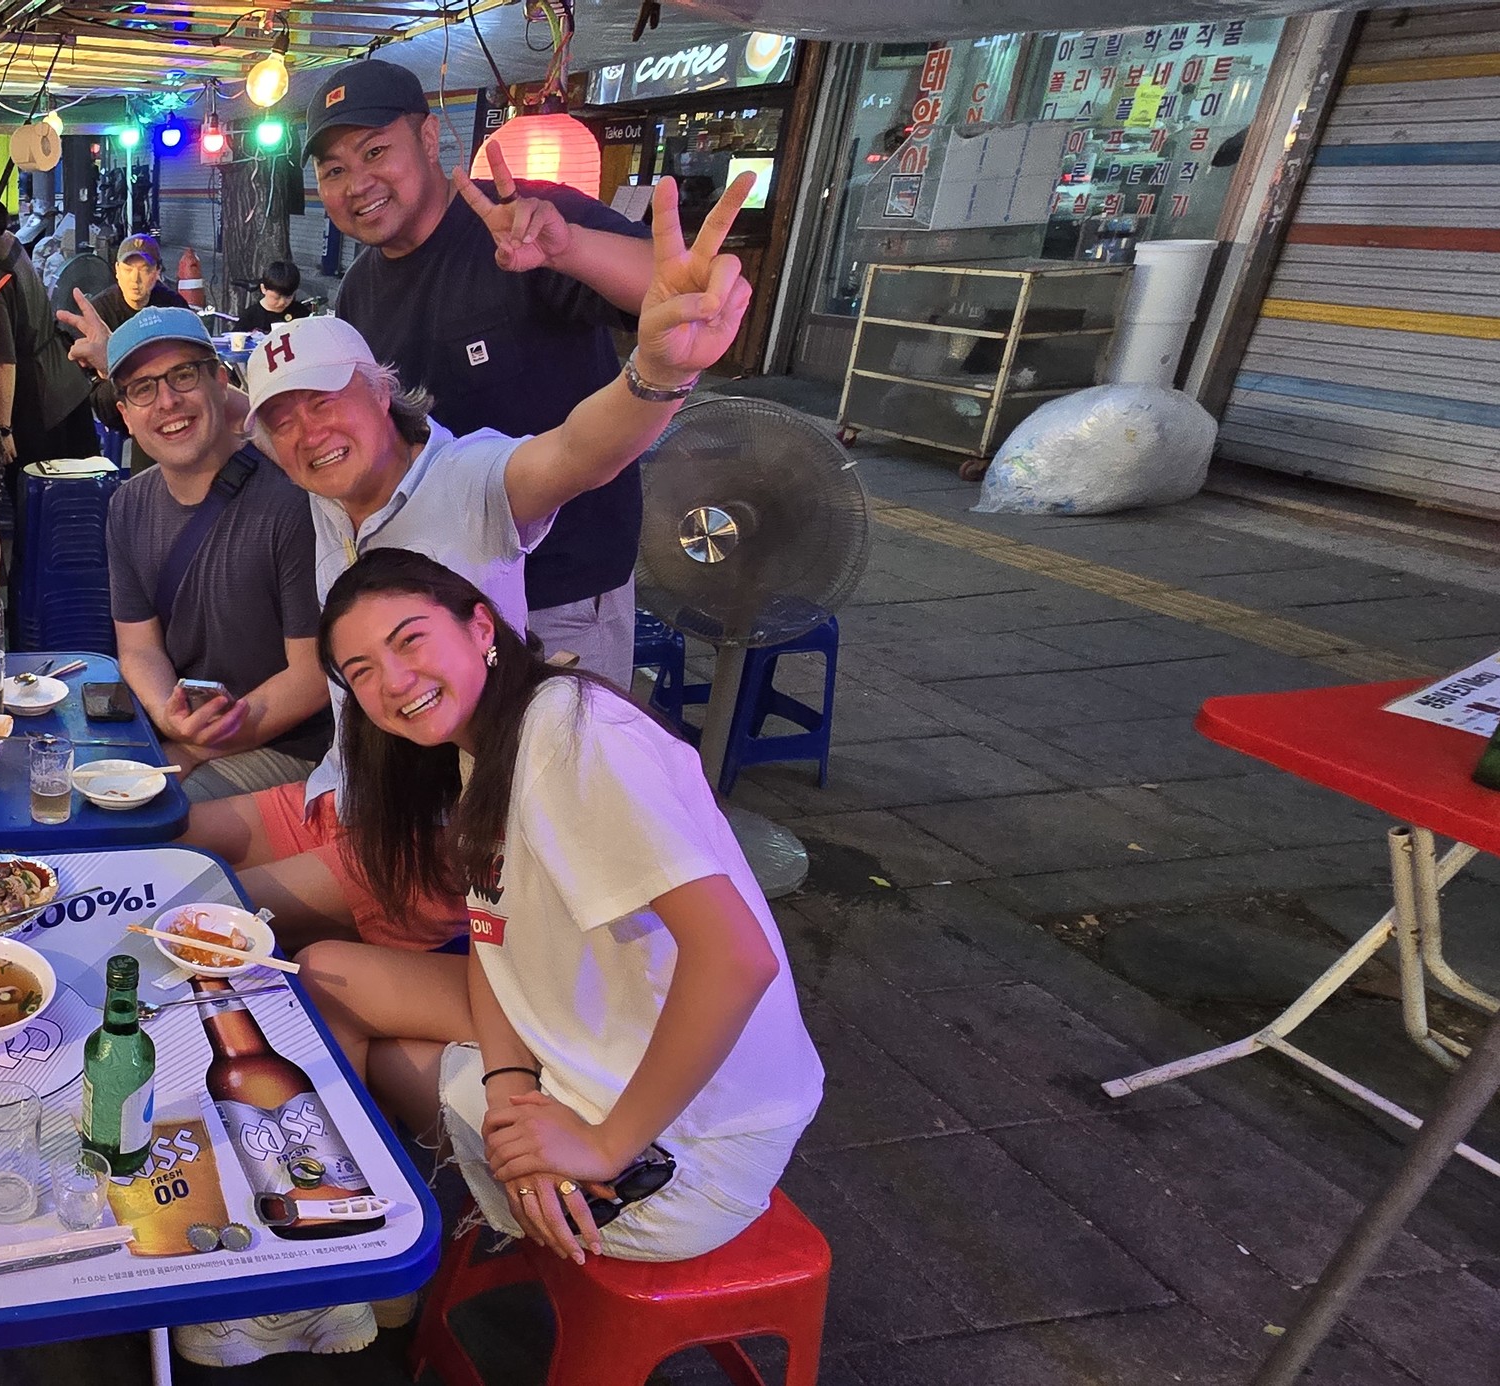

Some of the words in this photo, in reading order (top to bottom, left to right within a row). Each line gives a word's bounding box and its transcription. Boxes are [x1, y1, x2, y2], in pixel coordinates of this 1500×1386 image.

[1143, 21, 1246, 51] 학생작품
[1050, 56, 1234, 93] 폴리카보네이트
[605, 127, 623, 140] Take
[625, 125, 642, 139] Out
[264, 333, 295, 373] H
[21, 883, 157, 933] 00%!
[276, 1145, 311, 1166] FRESH
[150, 1168, 184, 1187] FRESH
[154, 1178, 190, 1206] 0.0
[72, 1277, 87, 1285] 카스
